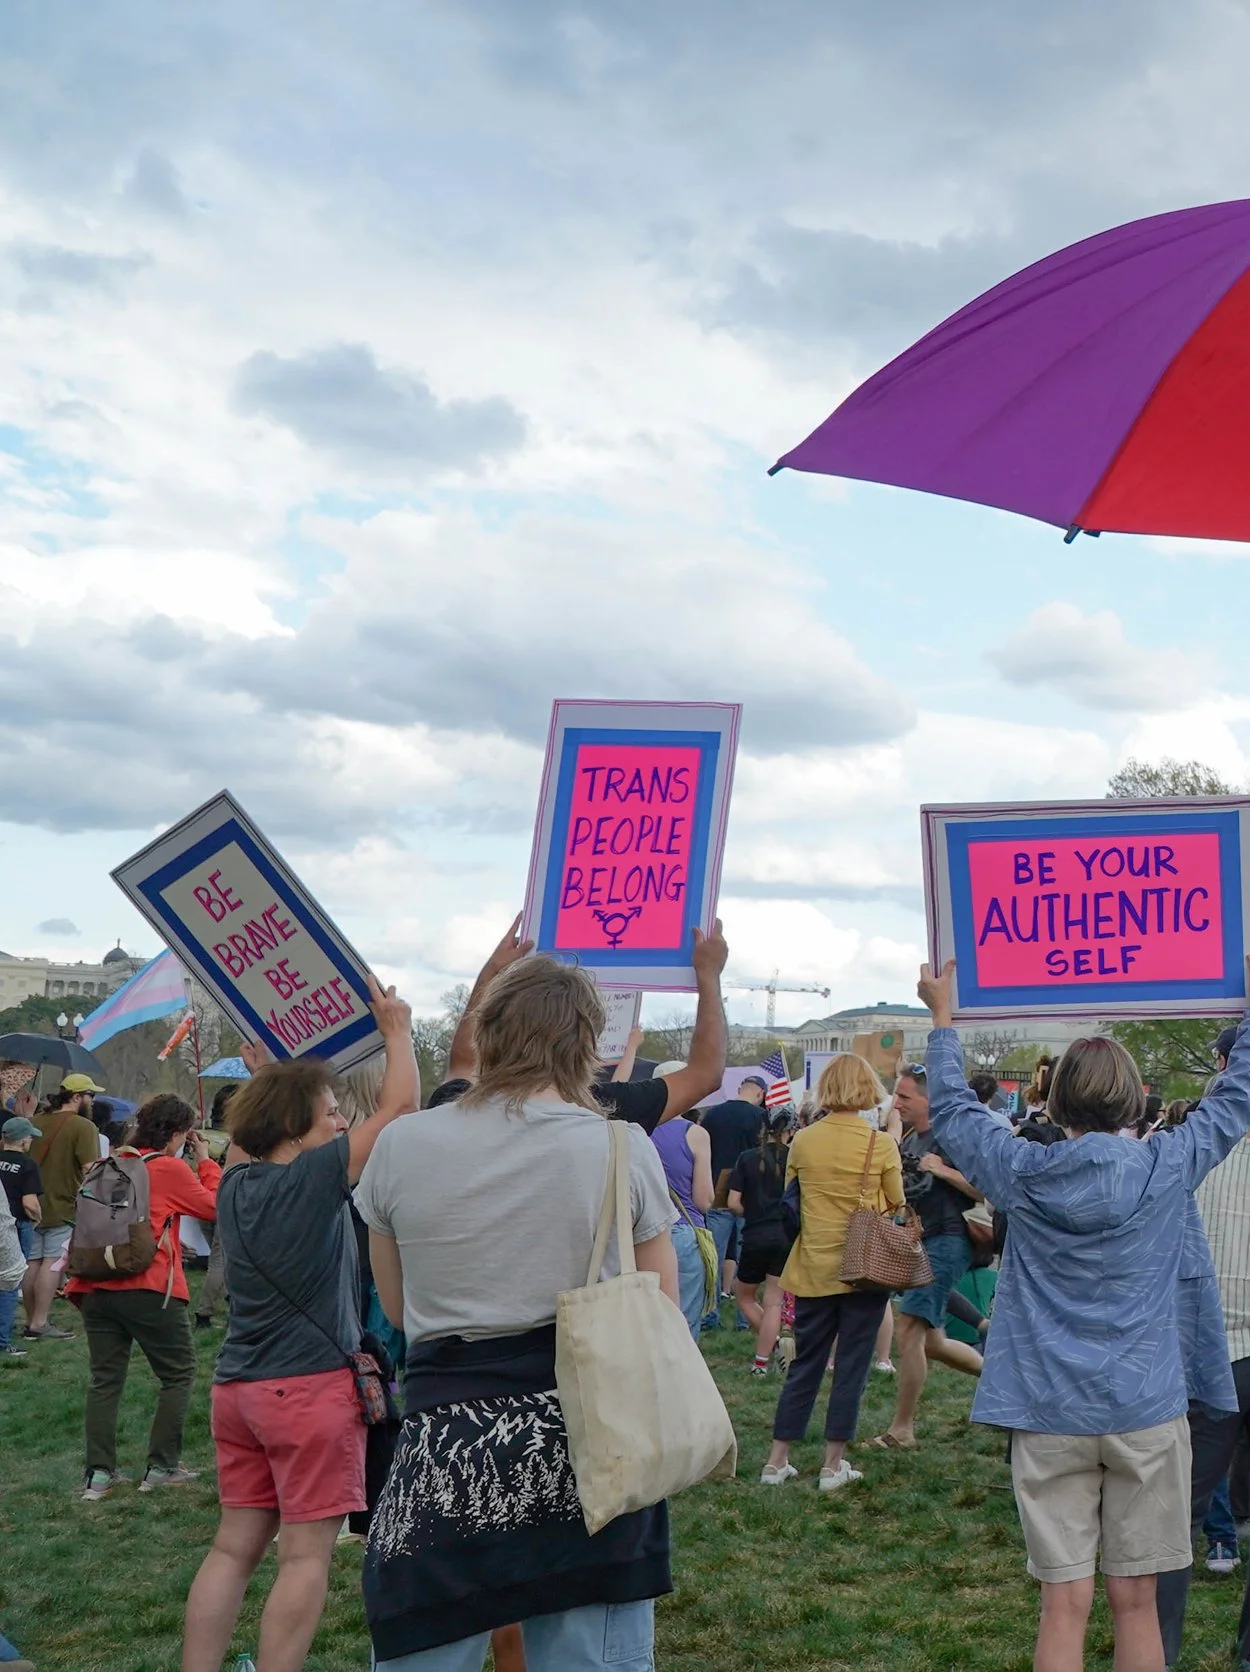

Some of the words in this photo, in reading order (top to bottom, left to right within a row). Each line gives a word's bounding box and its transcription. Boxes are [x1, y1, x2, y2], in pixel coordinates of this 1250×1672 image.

[582, 766, 690, 804] TRANS
[569, 814, 685, 856] PEOPLE
[561, 862, 685, 909] BELONG
[1013, 851, 1057, 886] BE
[1074, 845, 1179, 881] YOUR
[192, 868, 244, 923] BE
[978, 886, 1210, 947] AUTHENTIC
[212, 902, 298, 979] BRAVE
[1045, 944, 1142, 977] SELF
[263, 957, 309, 1001] BE
[265, 975, 356, 1051] YOURSELF
